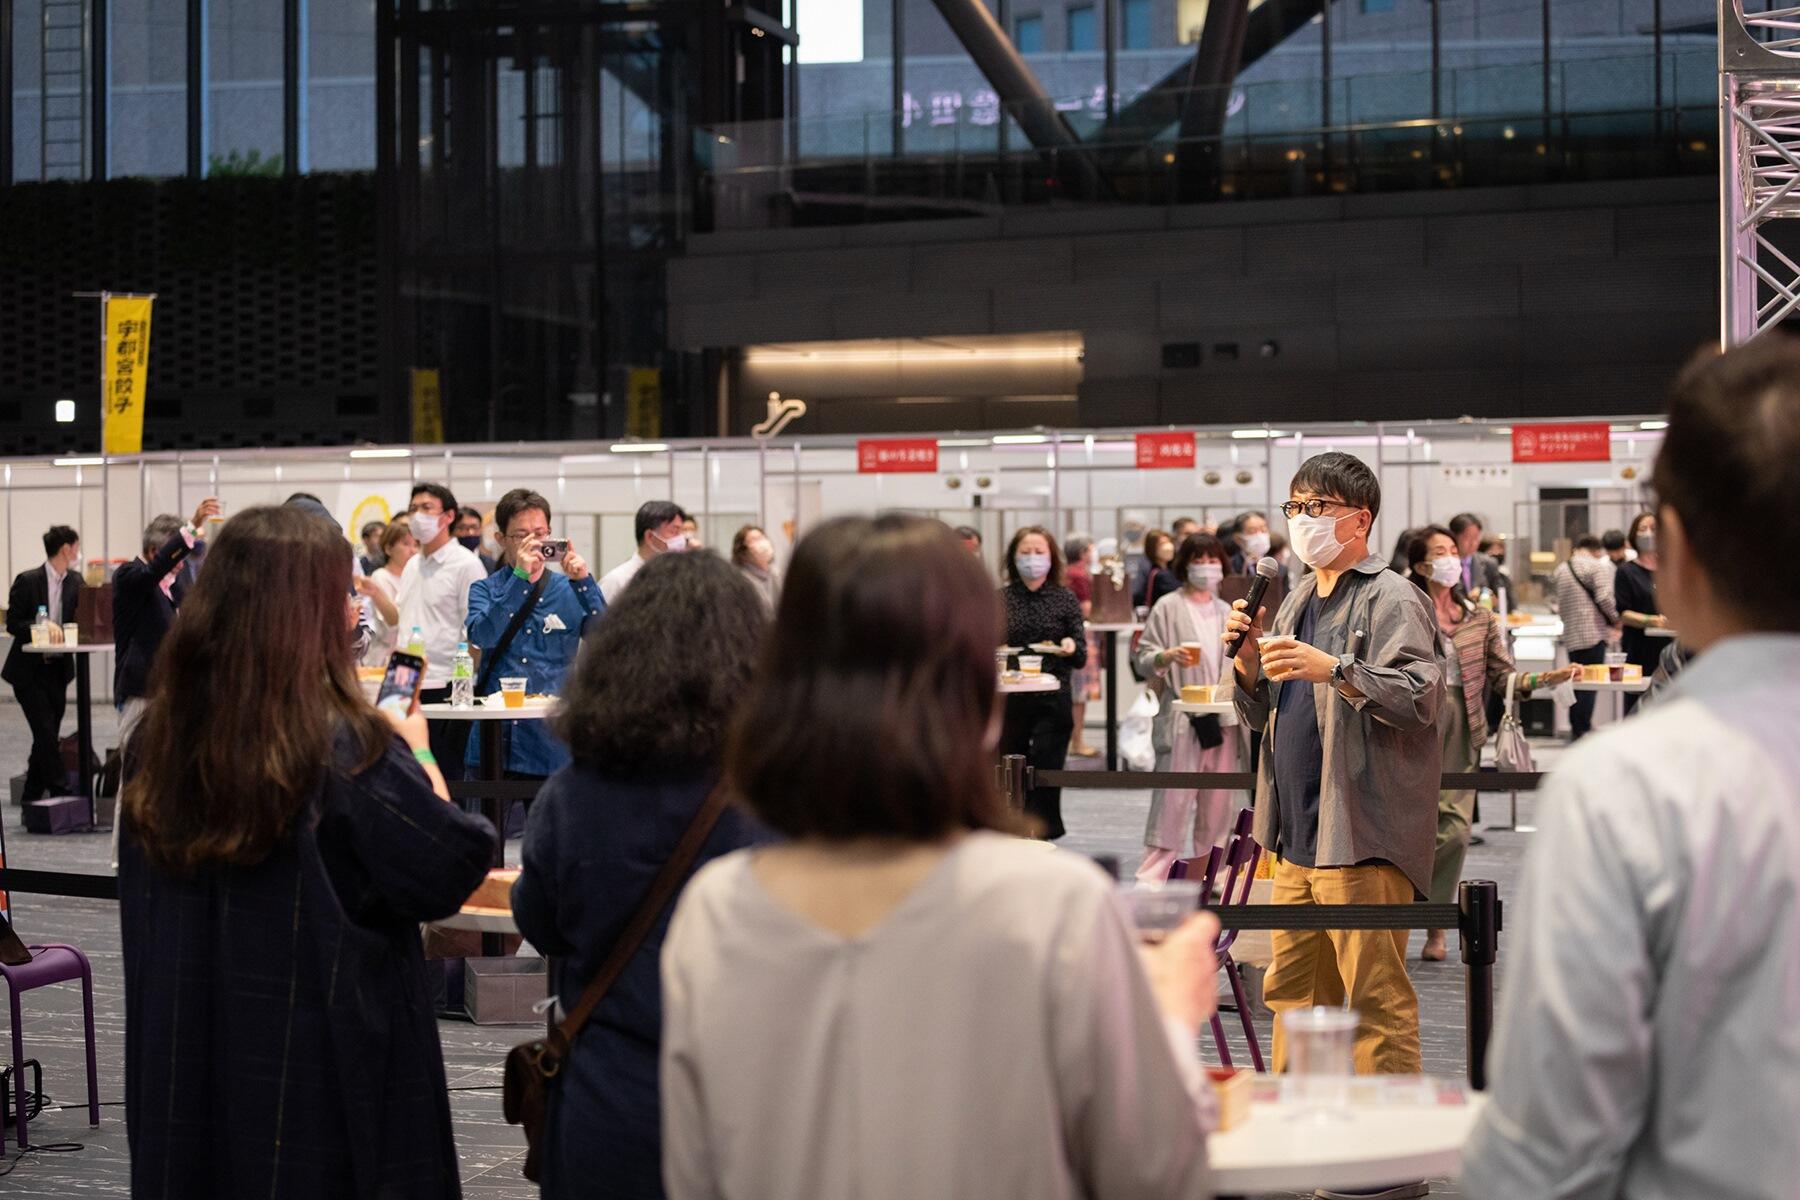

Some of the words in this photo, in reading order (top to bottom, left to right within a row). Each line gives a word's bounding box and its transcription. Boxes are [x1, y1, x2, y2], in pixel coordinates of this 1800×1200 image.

[114, 320, 137, 413] 宇都宮餃子
